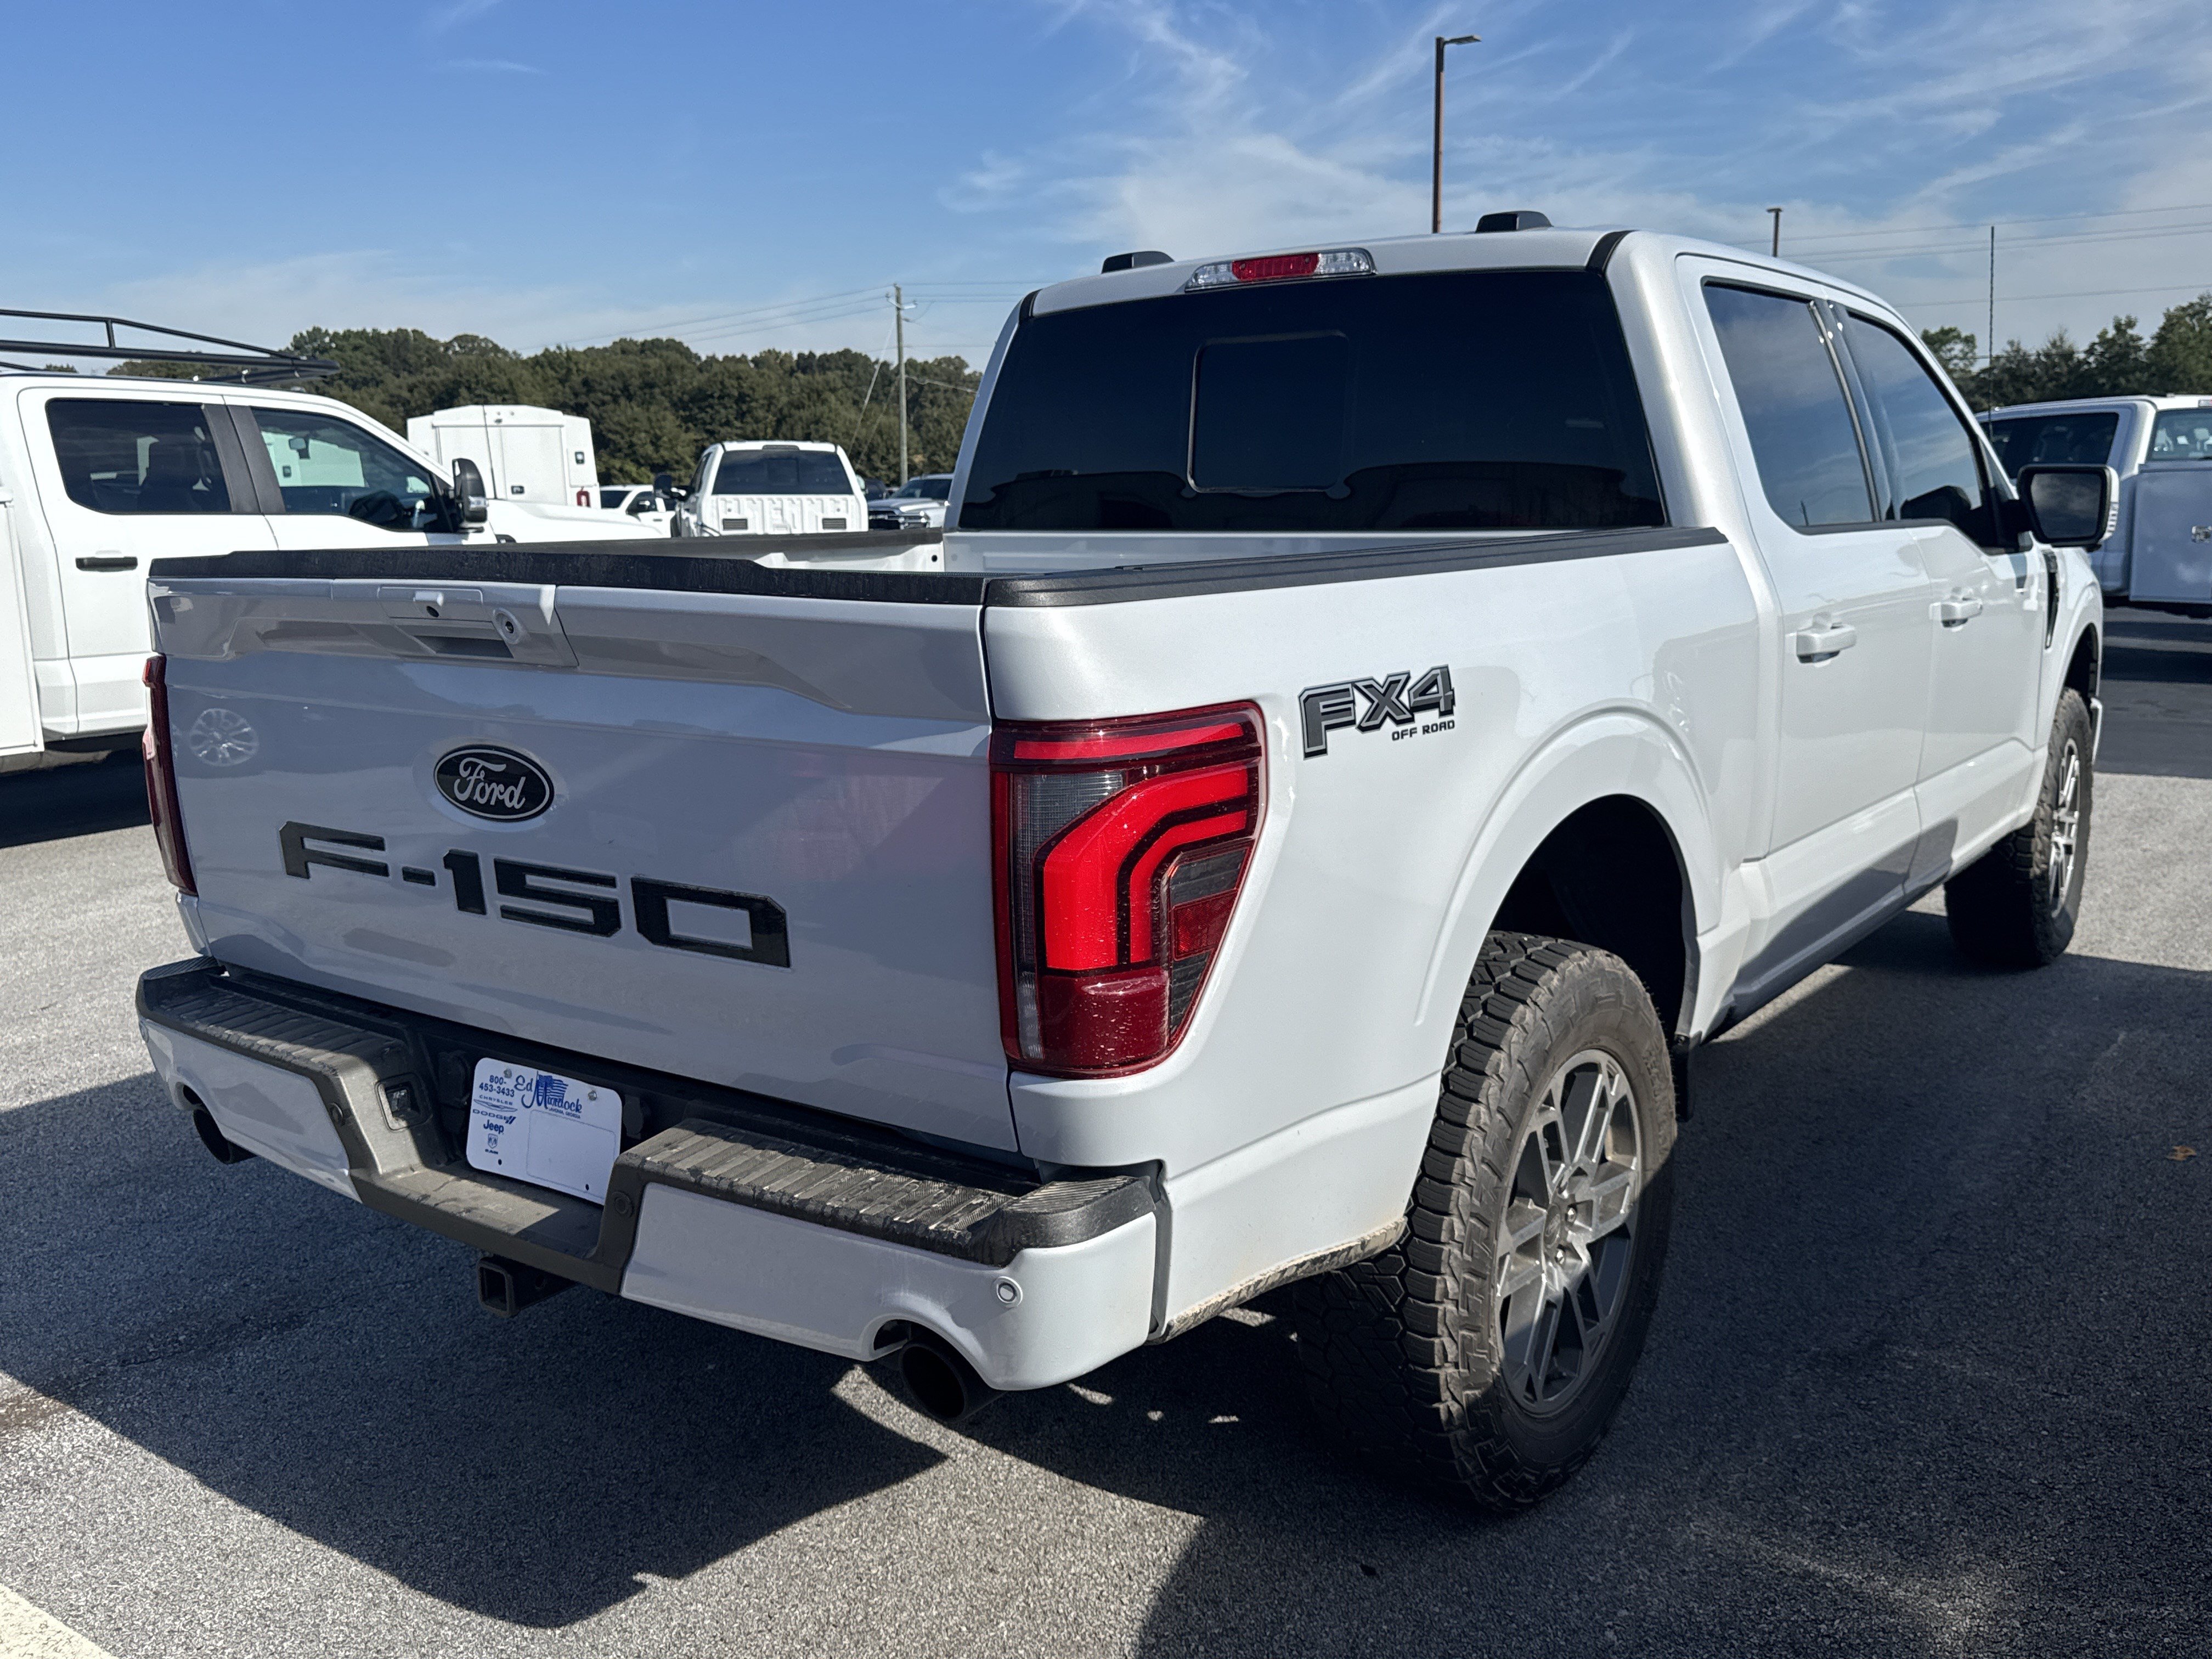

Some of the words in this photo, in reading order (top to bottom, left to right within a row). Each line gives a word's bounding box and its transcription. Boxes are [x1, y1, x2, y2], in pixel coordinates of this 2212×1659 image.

[1297, 664, 1455, 760] FX4
[1391, 727, 1418, 741] OFF
[1422, 720, 1455, 735] ROAD
[453, 755, 526, 810] Ford
[279, 821, 791, 967] F-150
[479, 1082, 515, 1097] 453-3433
[514, 1075, 534, 1092] Ed
[521, 1071, 582, 1113] Murdock
[479, 1095, 513, 1105] CHRYSLER
[472, 1109, 509, 1121] DODGE
[483, 1119, 504, 1135] Jeep
